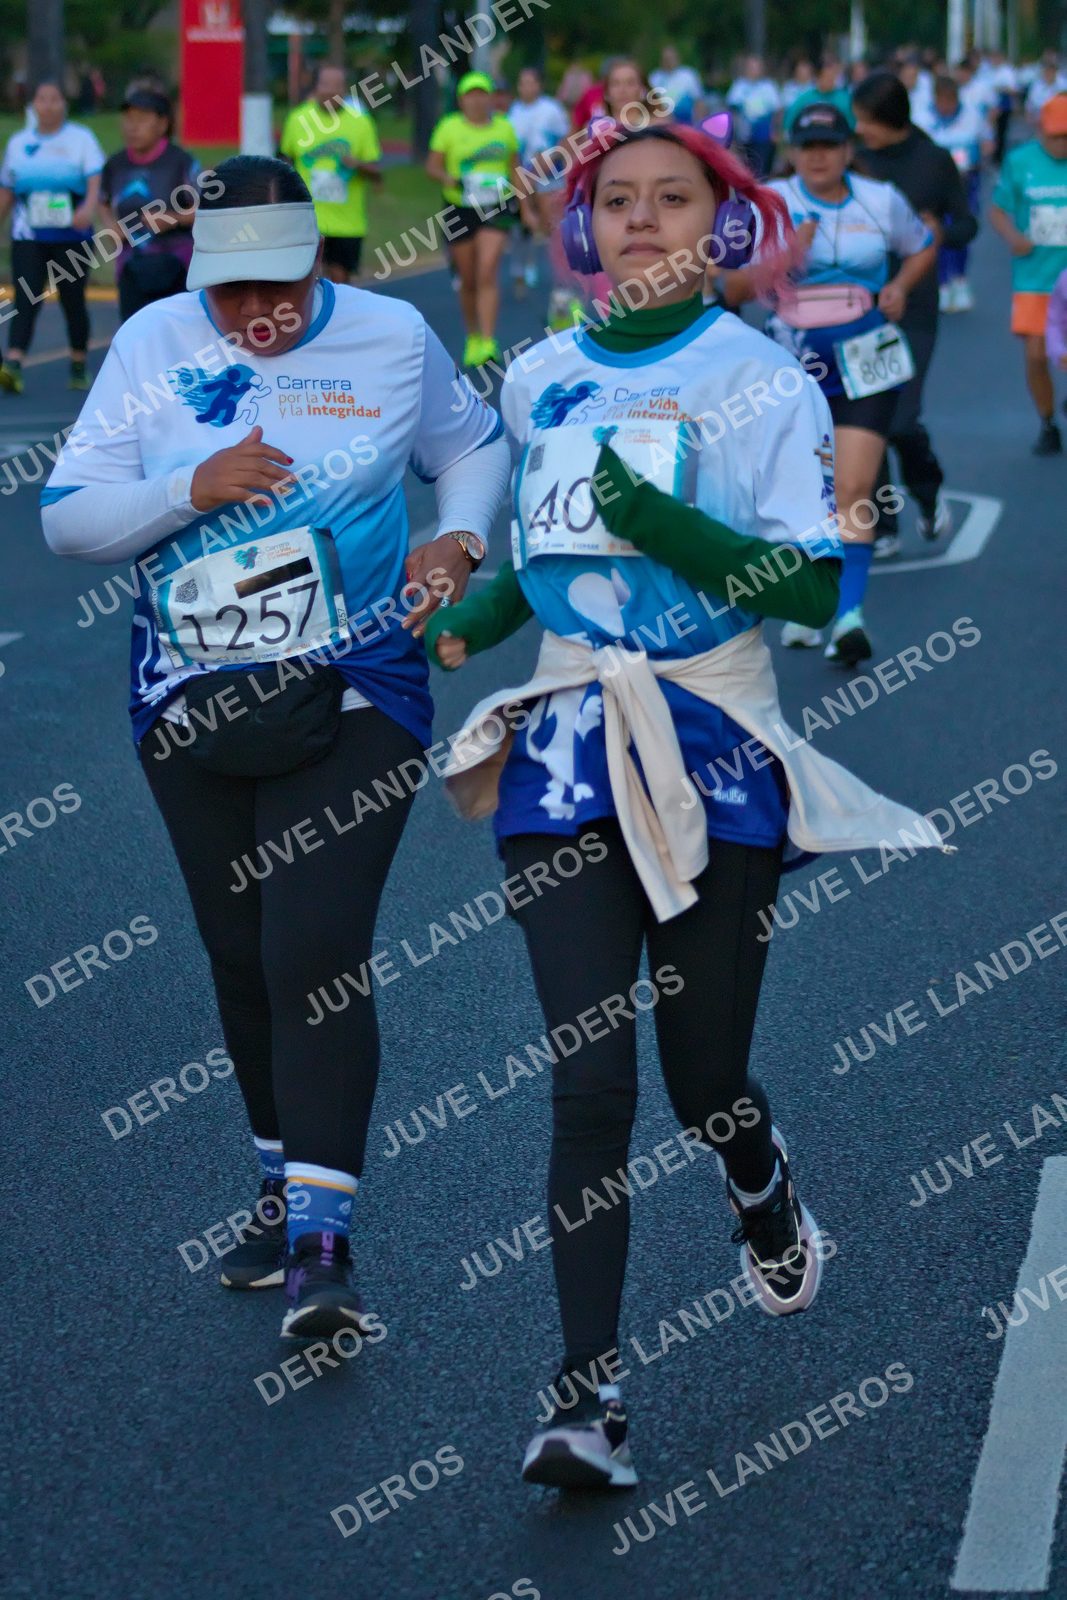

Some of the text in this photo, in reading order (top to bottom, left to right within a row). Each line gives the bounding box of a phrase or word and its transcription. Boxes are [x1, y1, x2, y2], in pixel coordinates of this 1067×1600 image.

[860, 350, 901, 386] 806
[277, 375, 351, 390] Carrera
[278, 391, 355, 406] por la Vida
[648, 398, 679, 411] Vida
[279, 405, 381, 419] y la Integridad
[182, 579, 320, 652] 1257
